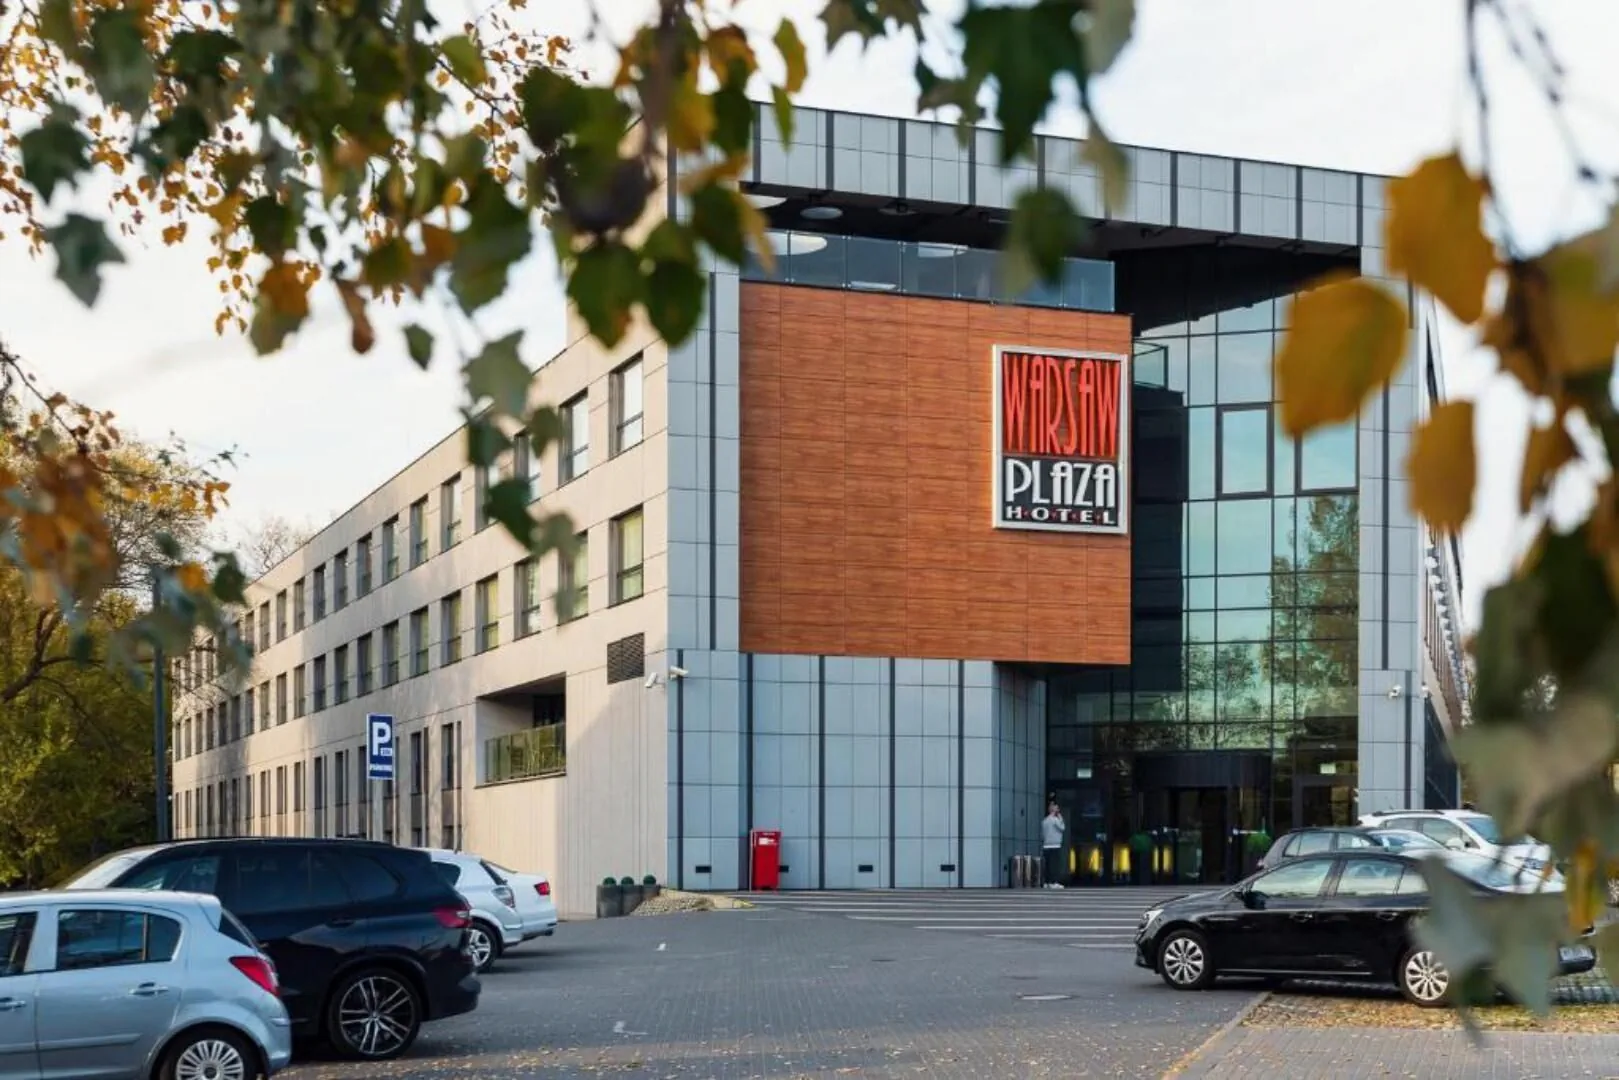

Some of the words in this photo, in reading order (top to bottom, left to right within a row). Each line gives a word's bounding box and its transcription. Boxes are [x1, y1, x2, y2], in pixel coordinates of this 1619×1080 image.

[1003, 354, 1120, 456] WARSAW
[1005, 459, 1115, 507] PLAZA
[372, 722, 391, 756] P
